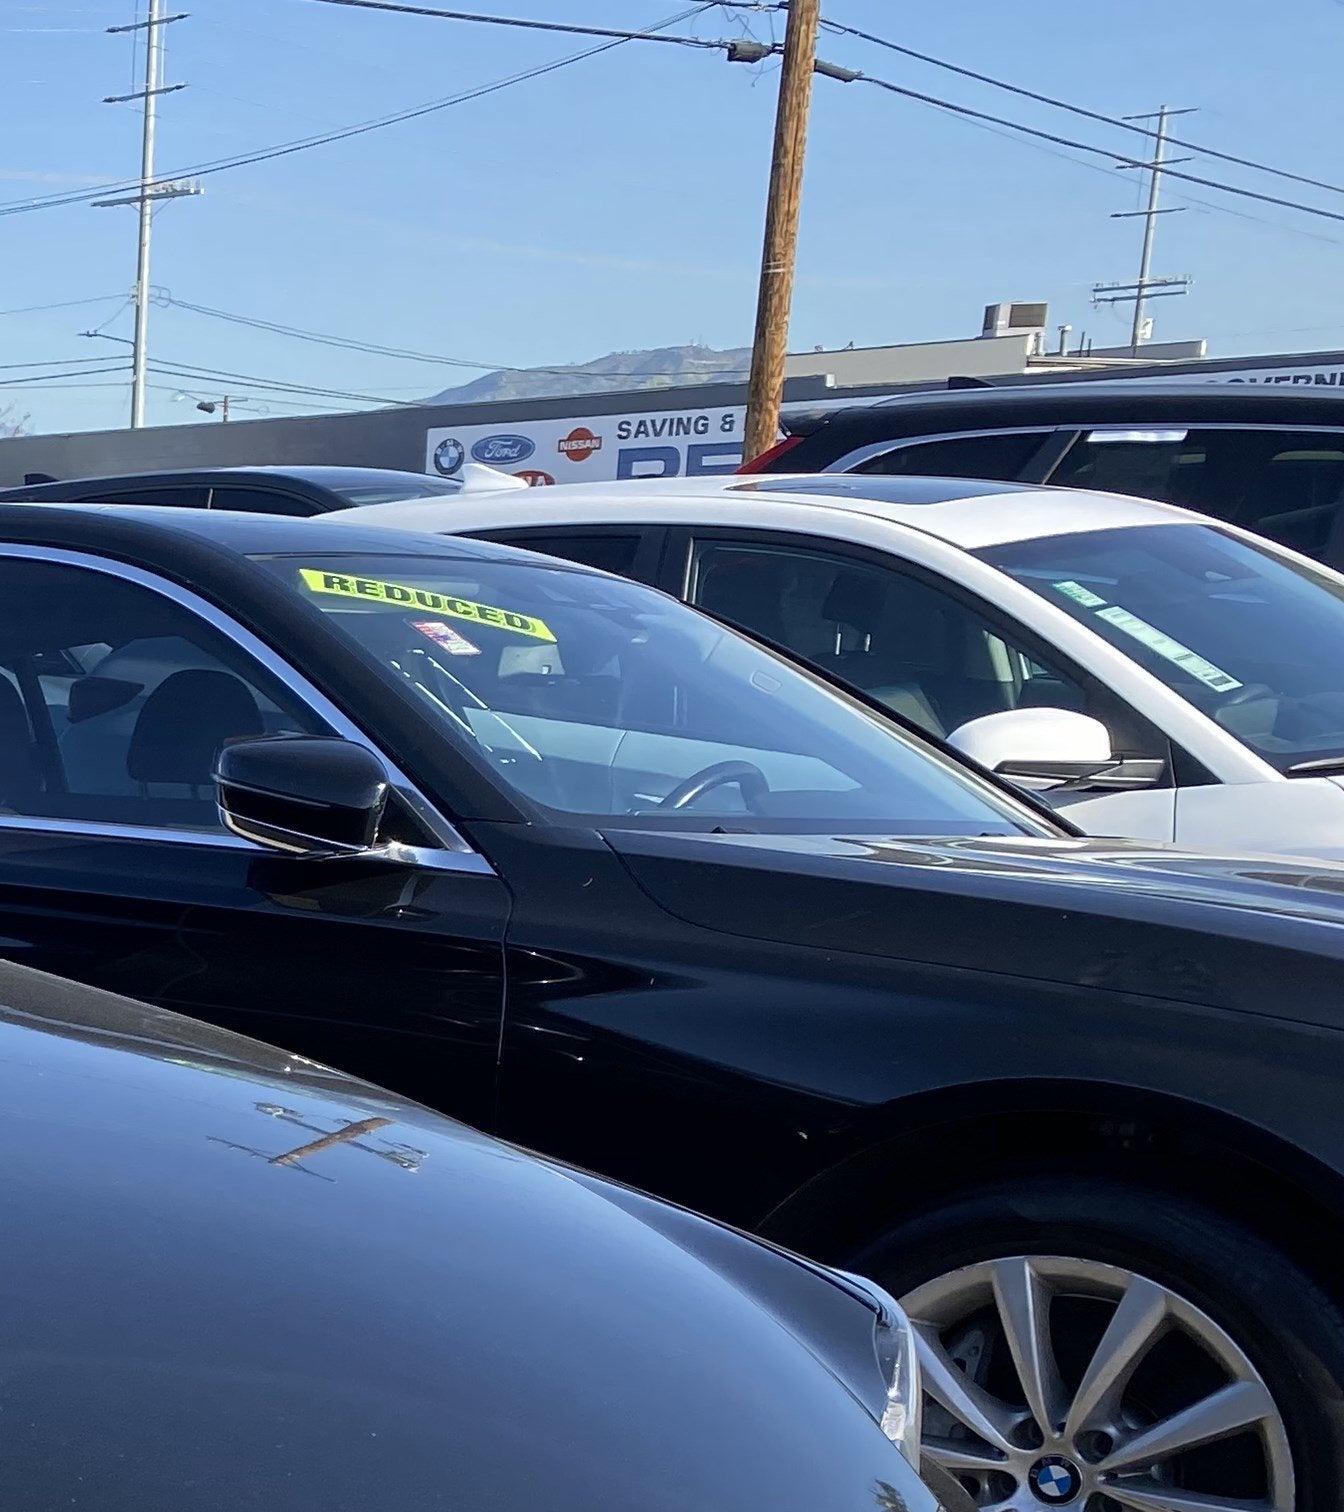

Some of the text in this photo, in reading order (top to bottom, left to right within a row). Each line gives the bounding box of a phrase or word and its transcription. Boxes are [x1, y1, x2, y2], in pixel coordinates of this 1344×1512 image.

[616, 413, 735, 441] SAVING &
[484, 439, 523, 459] Ford
[560, 436, 602, 452] NISSAN
[322, 573, 537, 632] REDUCED
